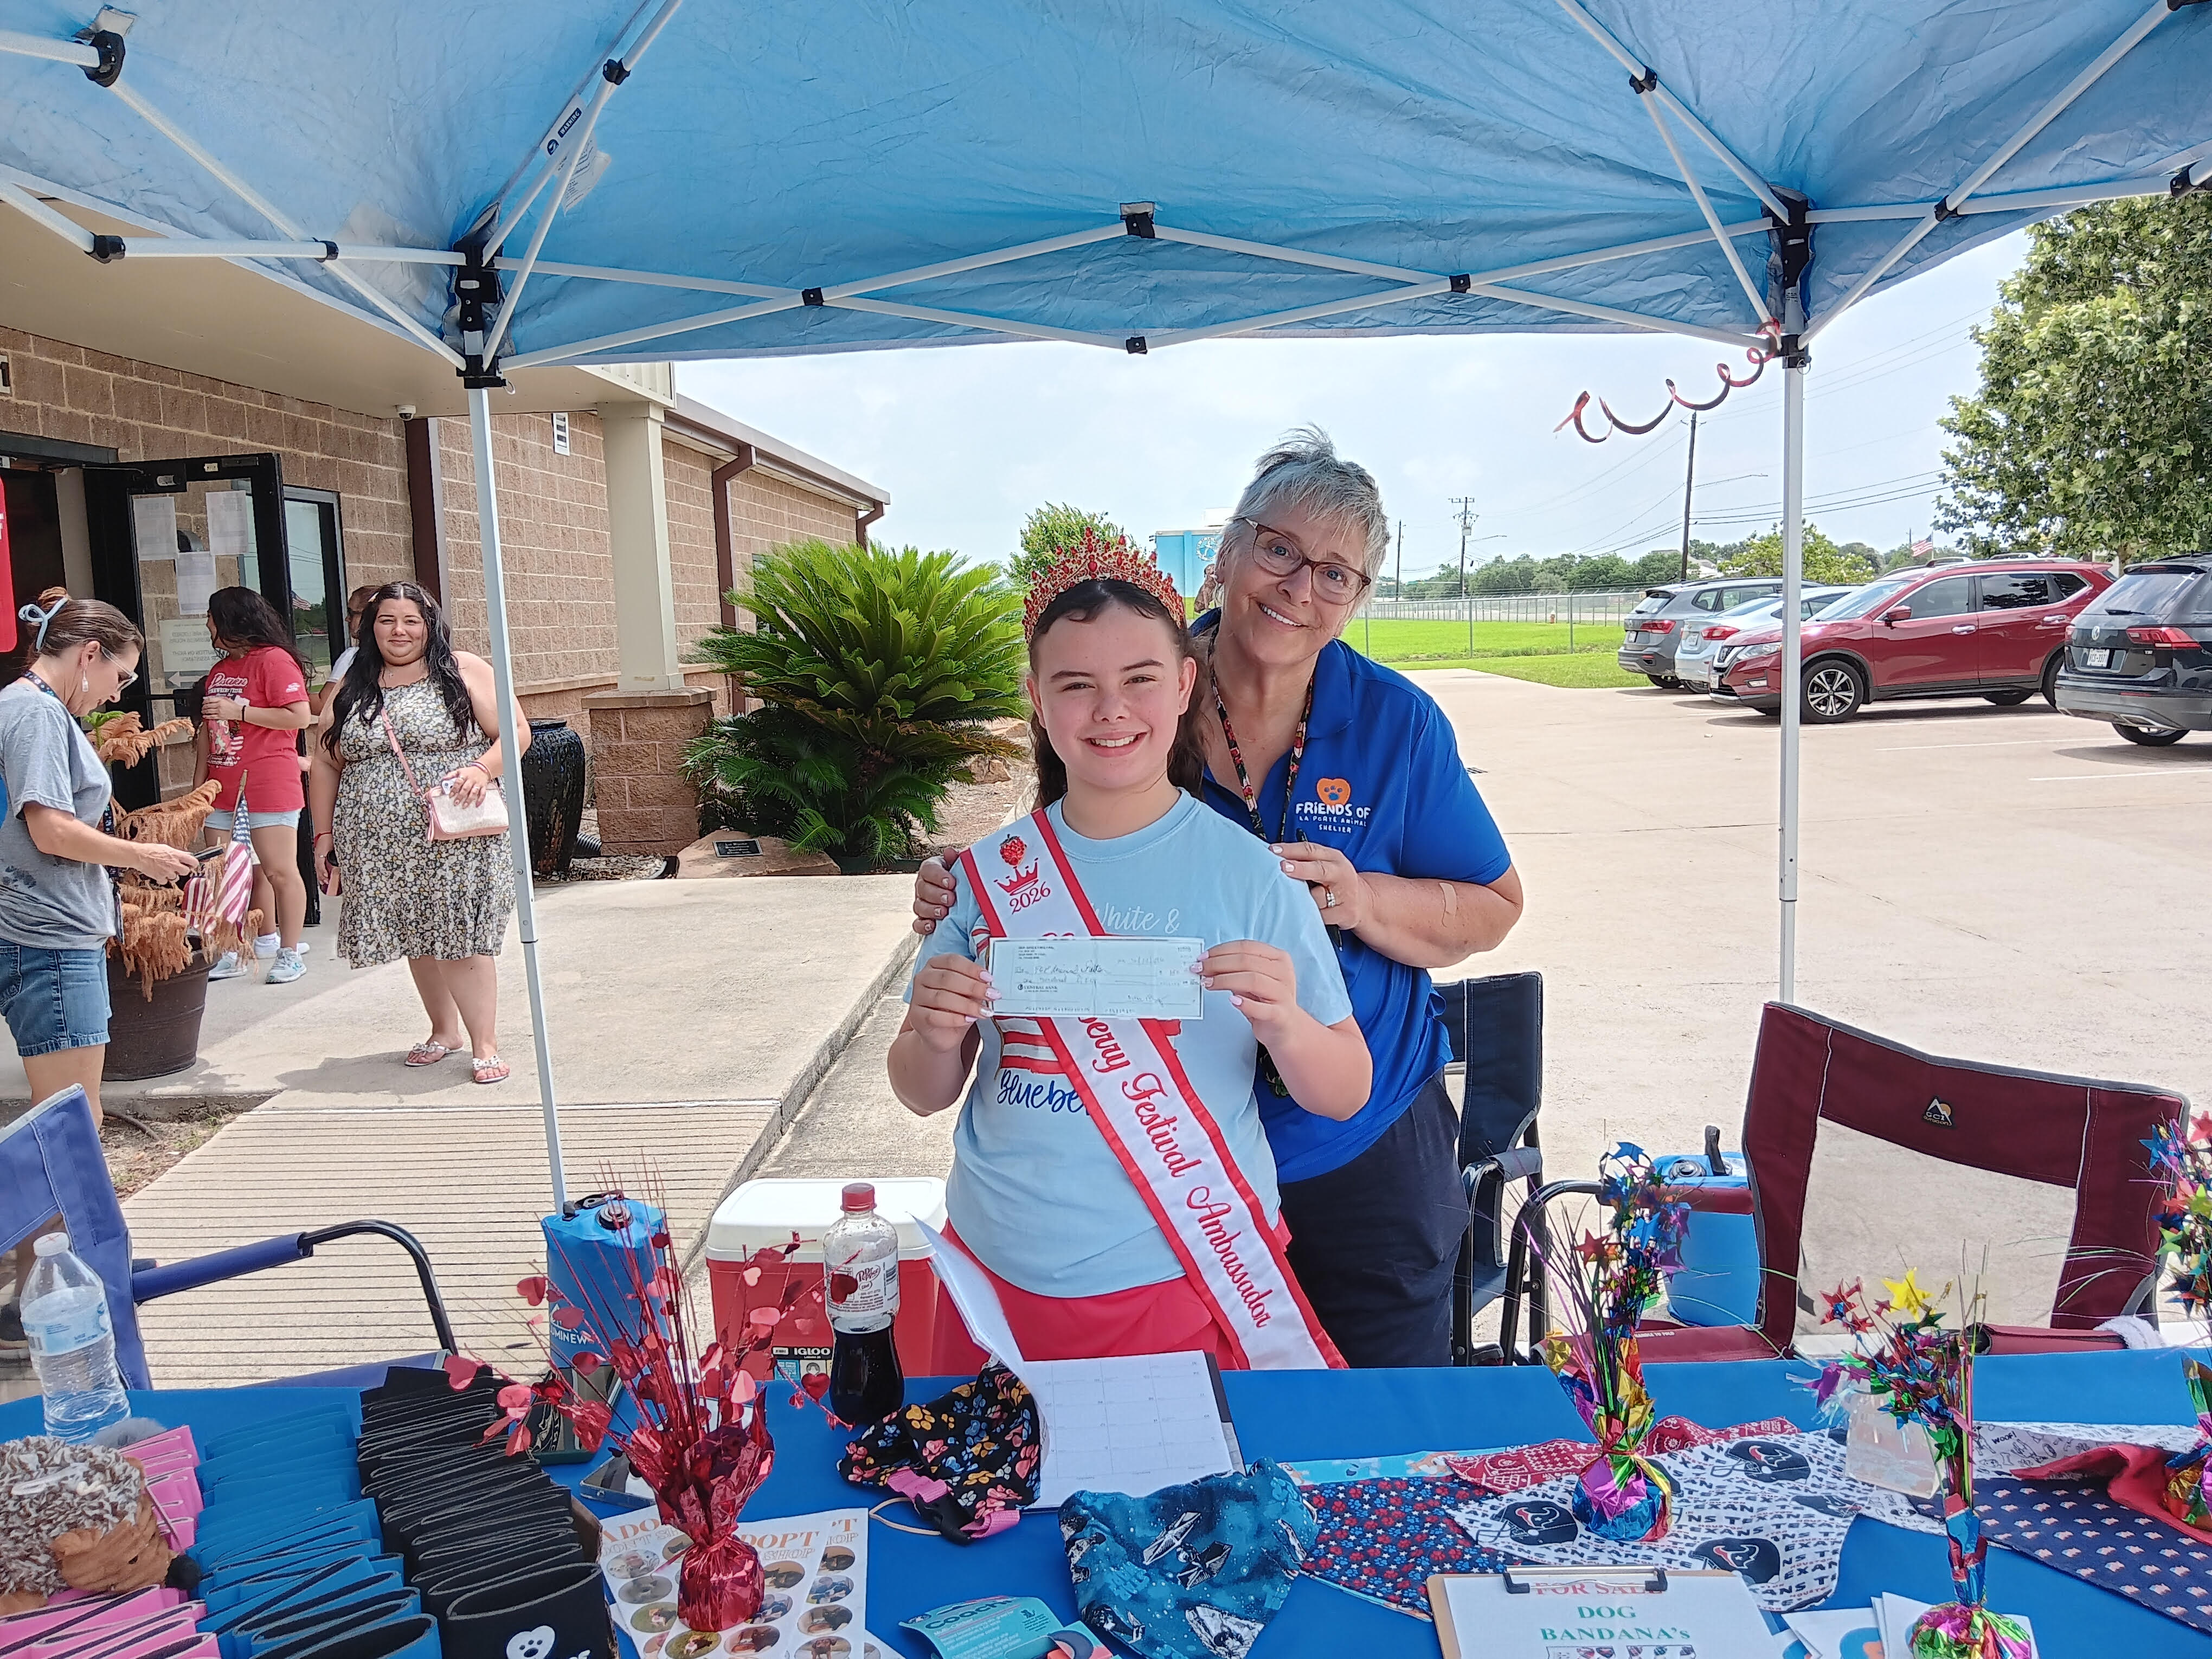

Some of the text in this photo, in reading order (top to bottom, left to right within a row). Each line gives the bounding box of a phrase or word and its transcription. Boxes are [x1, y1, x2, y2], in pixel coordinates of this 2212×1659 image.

[560, 110, 580, 136] WARNING
[1356, 807, 1371, 820] OF
[1009, 881, 1051, 915] 2026
[997, 1069, 1091, 1116] Bluebe
[1122, 1072, 1202, 1178] Festival
[1186, 1186, 1272, 1328] Ambassador
[794, 1347, 831, 1355] IGLOO
[1992, 1431, 2017, 1444] WOOF!
[603, 1519, 660, 1543] ADO
[1673, 1524, 1764, 1536] TEXANS
[741, 1531, 820, 1549] DOPT
[1535, 1582, 1663, 1594] FOR SAL
[1577, 1605, 1637, 1619] DOG
[1539, 1626, 1691, 1640] BANDANA's
